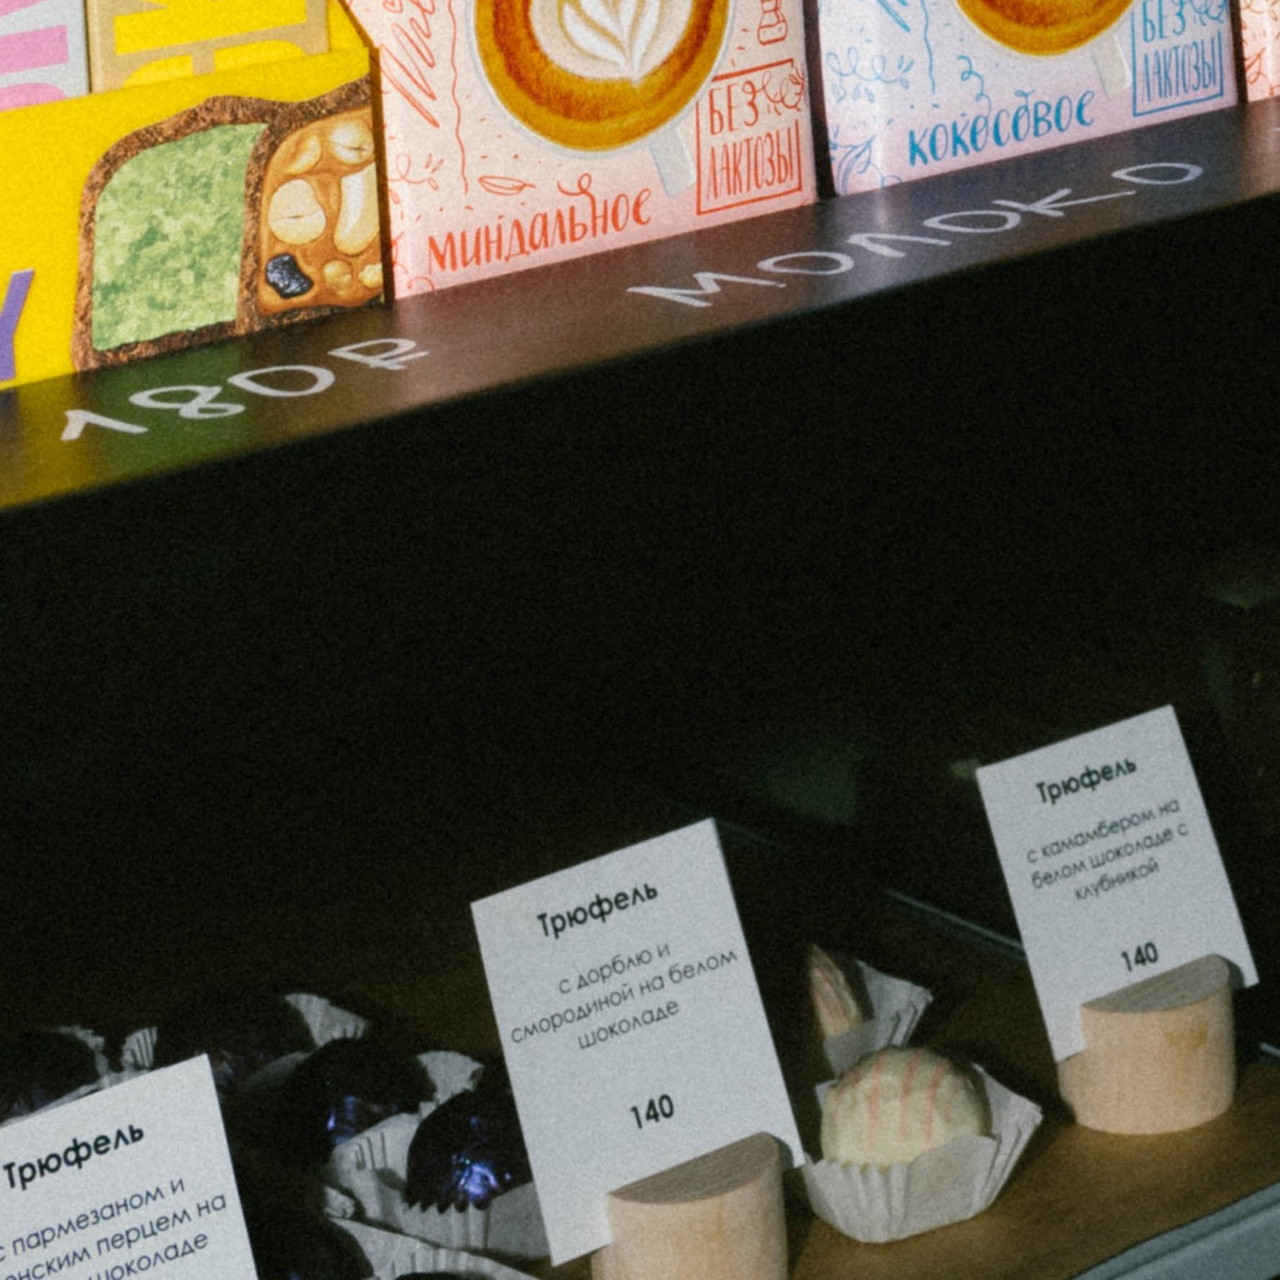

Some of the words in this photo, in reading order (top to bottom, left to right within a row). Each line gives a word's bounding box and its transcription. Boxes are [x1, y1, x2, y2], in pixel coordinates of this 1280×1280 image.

[1138, 28, 1222, 101] ЛАКТОЗЫ
[708, 79, 760, 136] БЕЗ
[705, 126, 794, 200] ЛАКТОЗЫ
[1035, 756, 1138, 806] Трюфель
[1026, 849, 1037, 864] с
[1041, 807, 1156, 859] камамбером
[1159, 798, 1181, 815] на
[1031, 860, 1087, 890] белом
[1090, 826, 1174, 870] шоколаде
[1177, 822, 1189, 838] с
[1074, 856, 1161, 902] клубникой
[536, 882, 660, 940] Трюфель
[558, 976, 572, 996] с
[576, 948, 654, 992] дорблю
[656, 942, 672, 960] и
[1121, 940, 1160, 972] 140
[509, 980, 637, 1044] смородиной
[638, 973, 665, 995] на
[668, 948, 739, 985] белом
[576, 997, 681, 1051] шоколаде
[630, 1093, 675, 1130] 140
[3, 1124, 145, 1191] Трюфель
[11, 1186, 166, 1256] пармезаном
[169, 1177, 186, 1193] и
[96, 1207, 192, 1256] перцем
[196, 1193, 227, 1219] на
